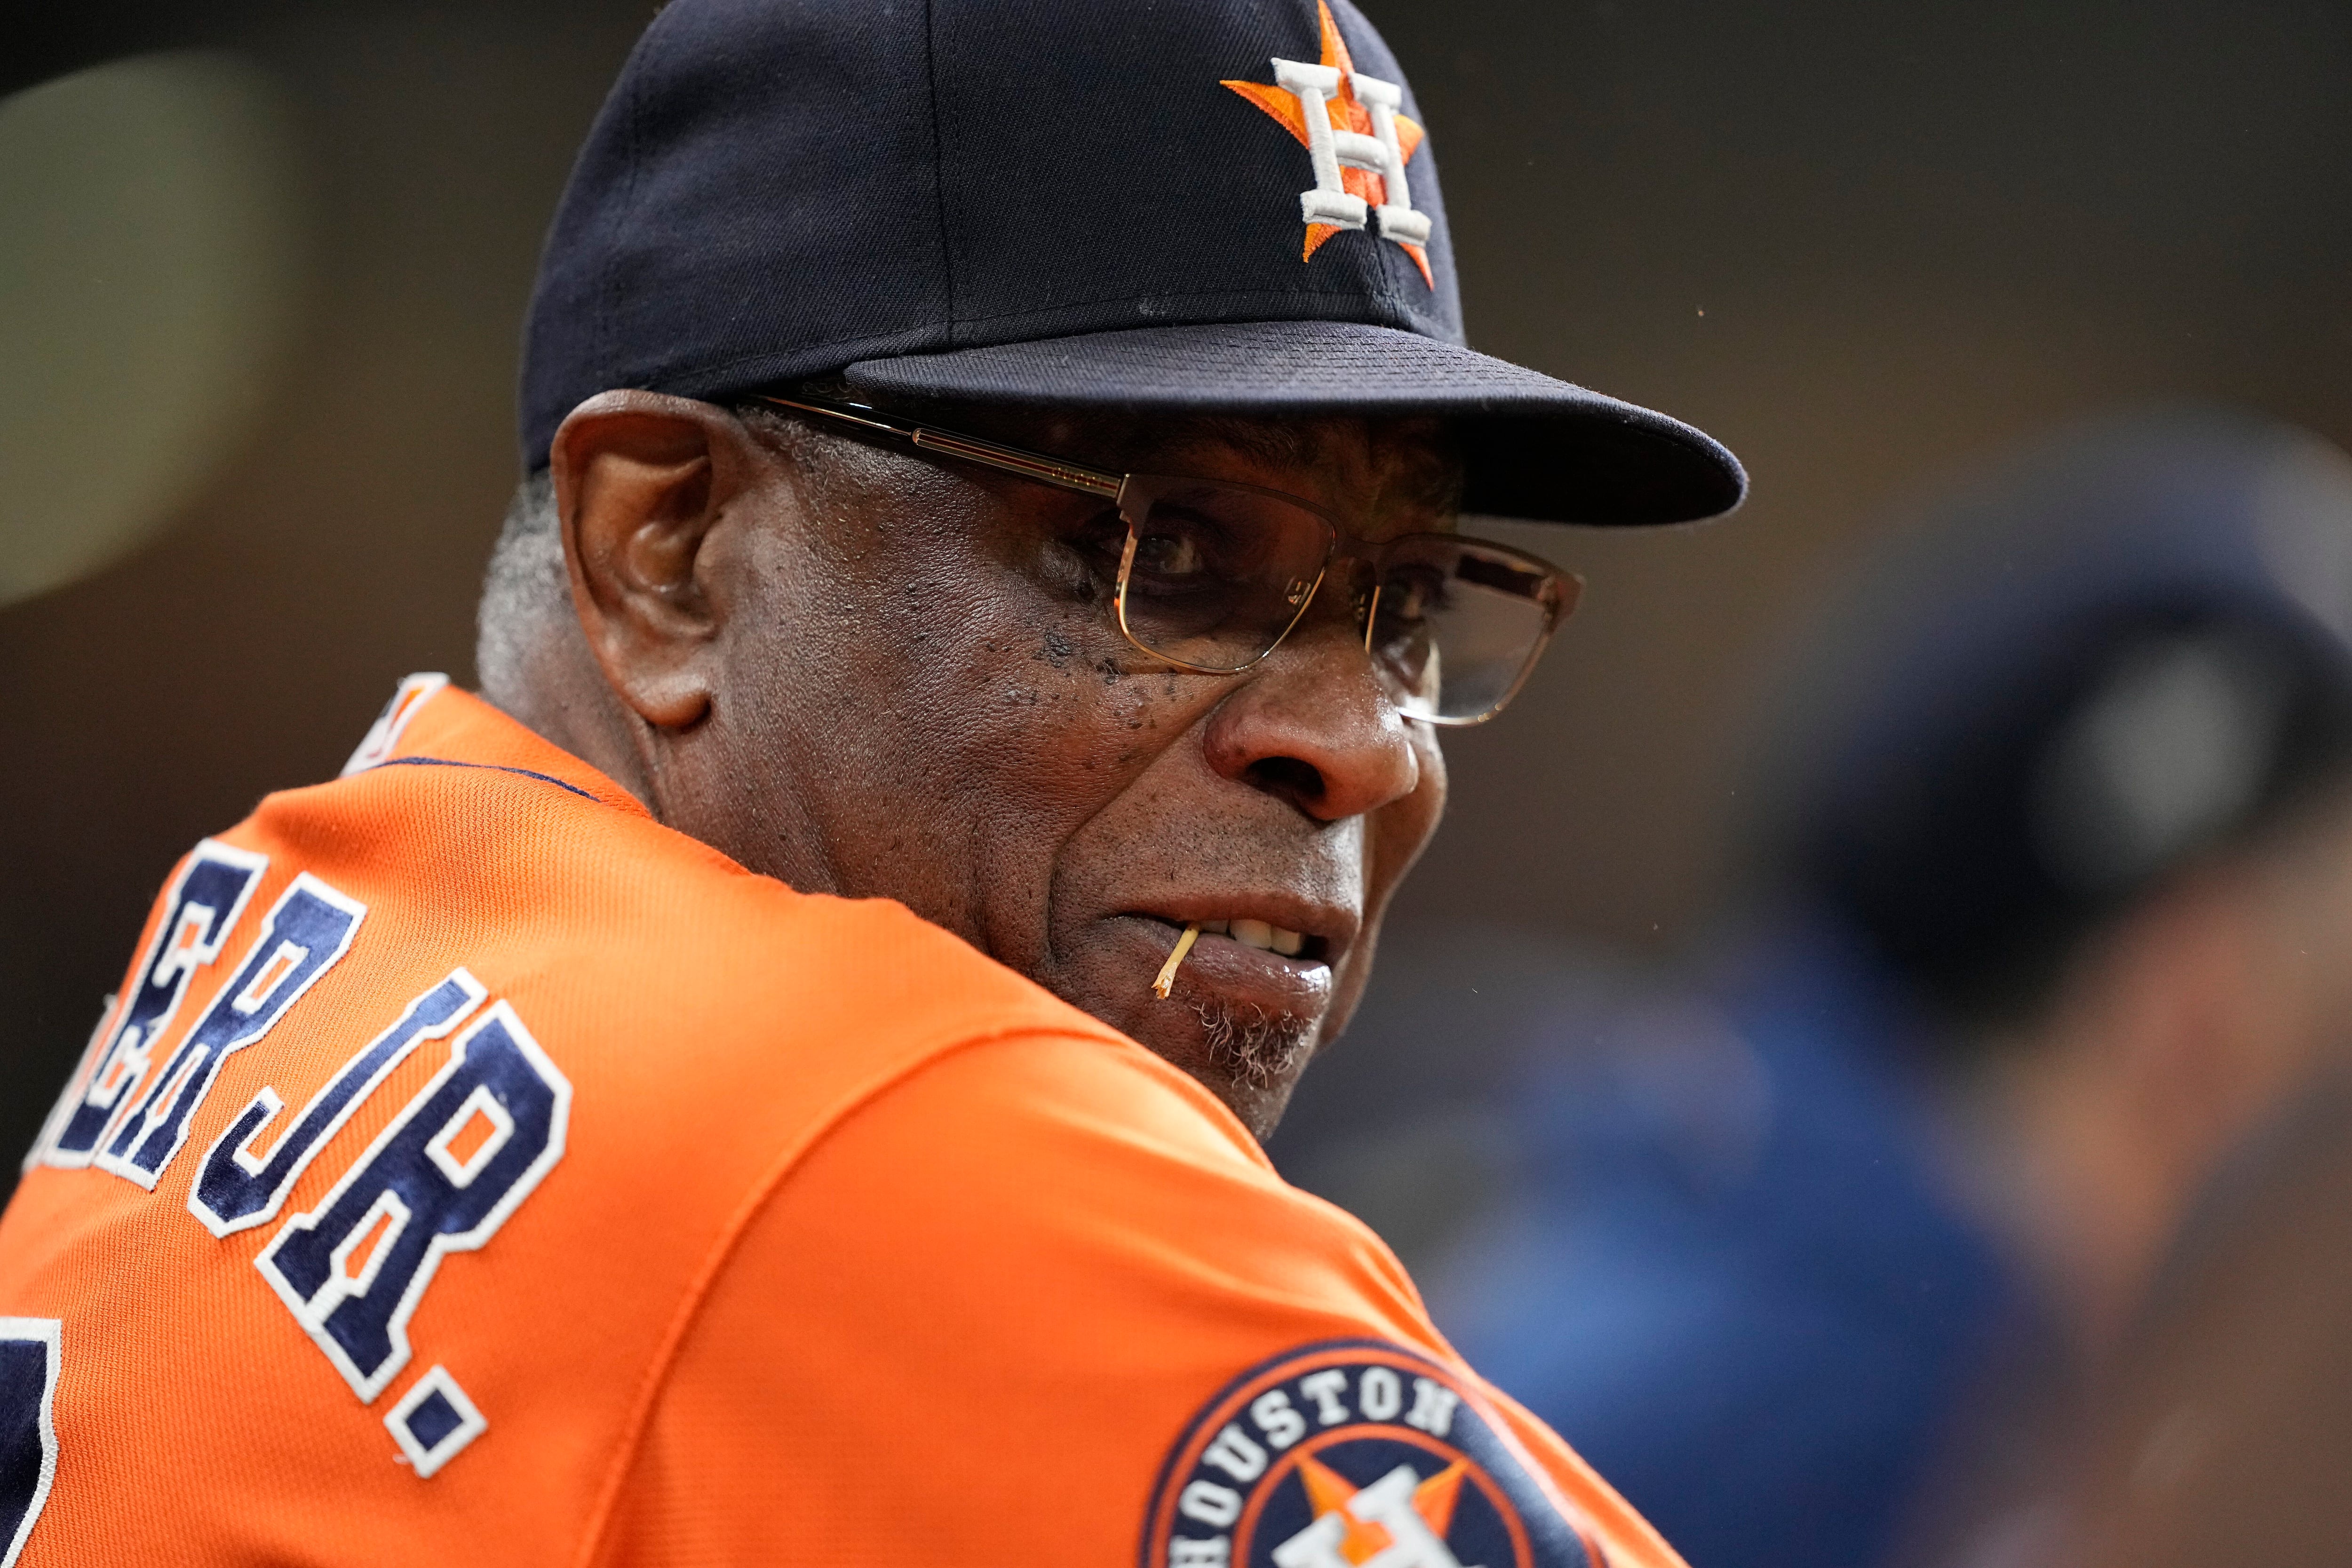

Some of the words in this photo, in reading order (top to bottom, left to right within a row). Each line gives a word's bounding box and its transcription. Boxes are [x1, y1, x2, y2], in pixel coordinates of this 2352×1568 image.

[1271, 58, 1432, 247] H
[22, 837, 368, 1192] ER
[187, 967, 572, 1478] JR.
[1168, 1366, 1459, 1568] HOUSTON
